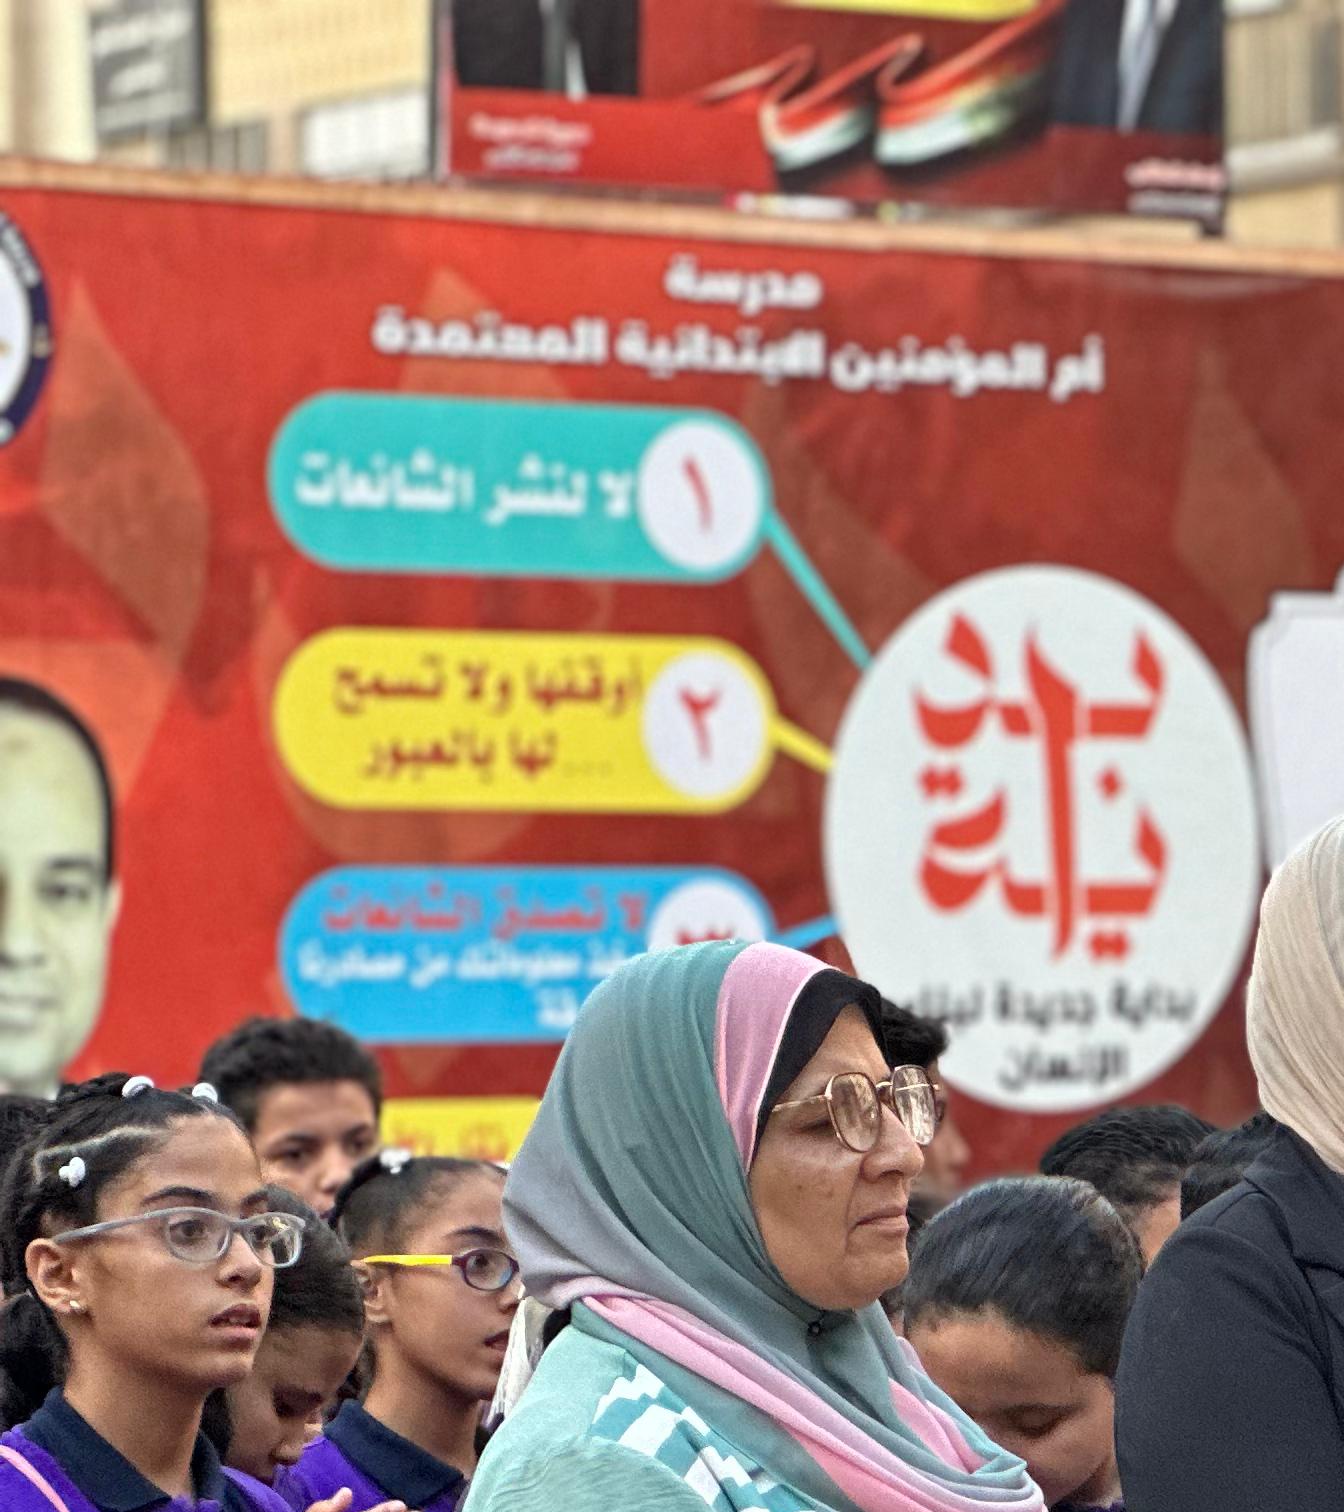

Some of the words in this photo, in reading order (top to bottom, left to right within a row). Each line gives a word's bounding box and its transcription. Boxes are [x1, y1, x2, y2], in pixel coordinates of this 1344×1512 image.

[664, 254, 823, 316] مدرسة
[371, 304, 609, 364] المعتمدة
[829, 334, 1047, 398] المؤمنين
[1050, 335, 1104, 402] أم
[294, 449, 475, 512] الشائعات
[598, 468, 634, 519] لا
[685, 455, 713, 534] ١
[679, 686, 720, 763] ٢
